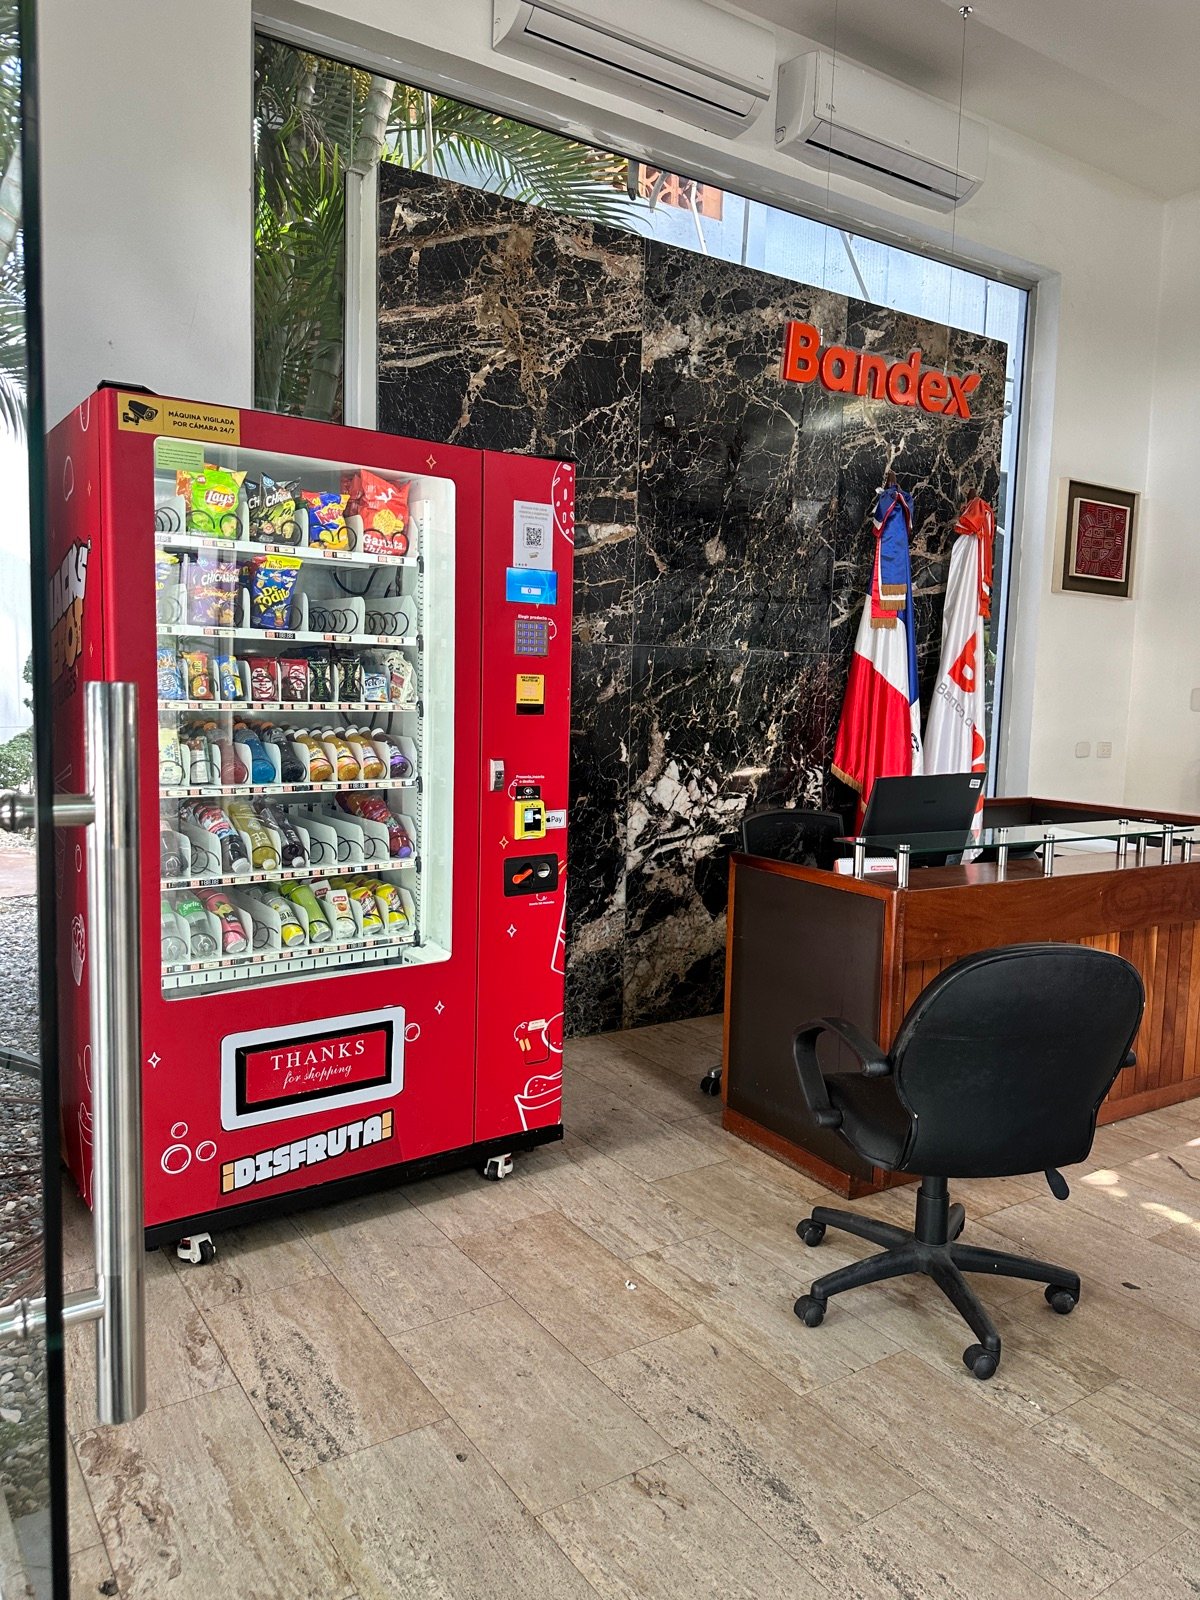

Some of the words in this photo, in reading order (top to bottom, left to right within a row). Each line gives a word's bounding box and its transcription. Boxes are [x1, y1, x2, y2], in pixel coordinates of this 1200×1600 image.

[783, 320, 982, 419] Bandex
[168, 410, 201, 421] MÁQUINA
[203, 414, 235, 426] VIGILADA
[173, 420, 188, 428] POR
[189, 422, 219, 432] CÁMARA
[220, 426, 235, 434] 24/7
[936, 682, 966, 719] Banco
[183, 901, 200, 910] Sprite
[270, 1040, 366, 1071] THANKS
[283, 1072, 301, 1089] for
[304, 1064, 352, 1084] shopping
